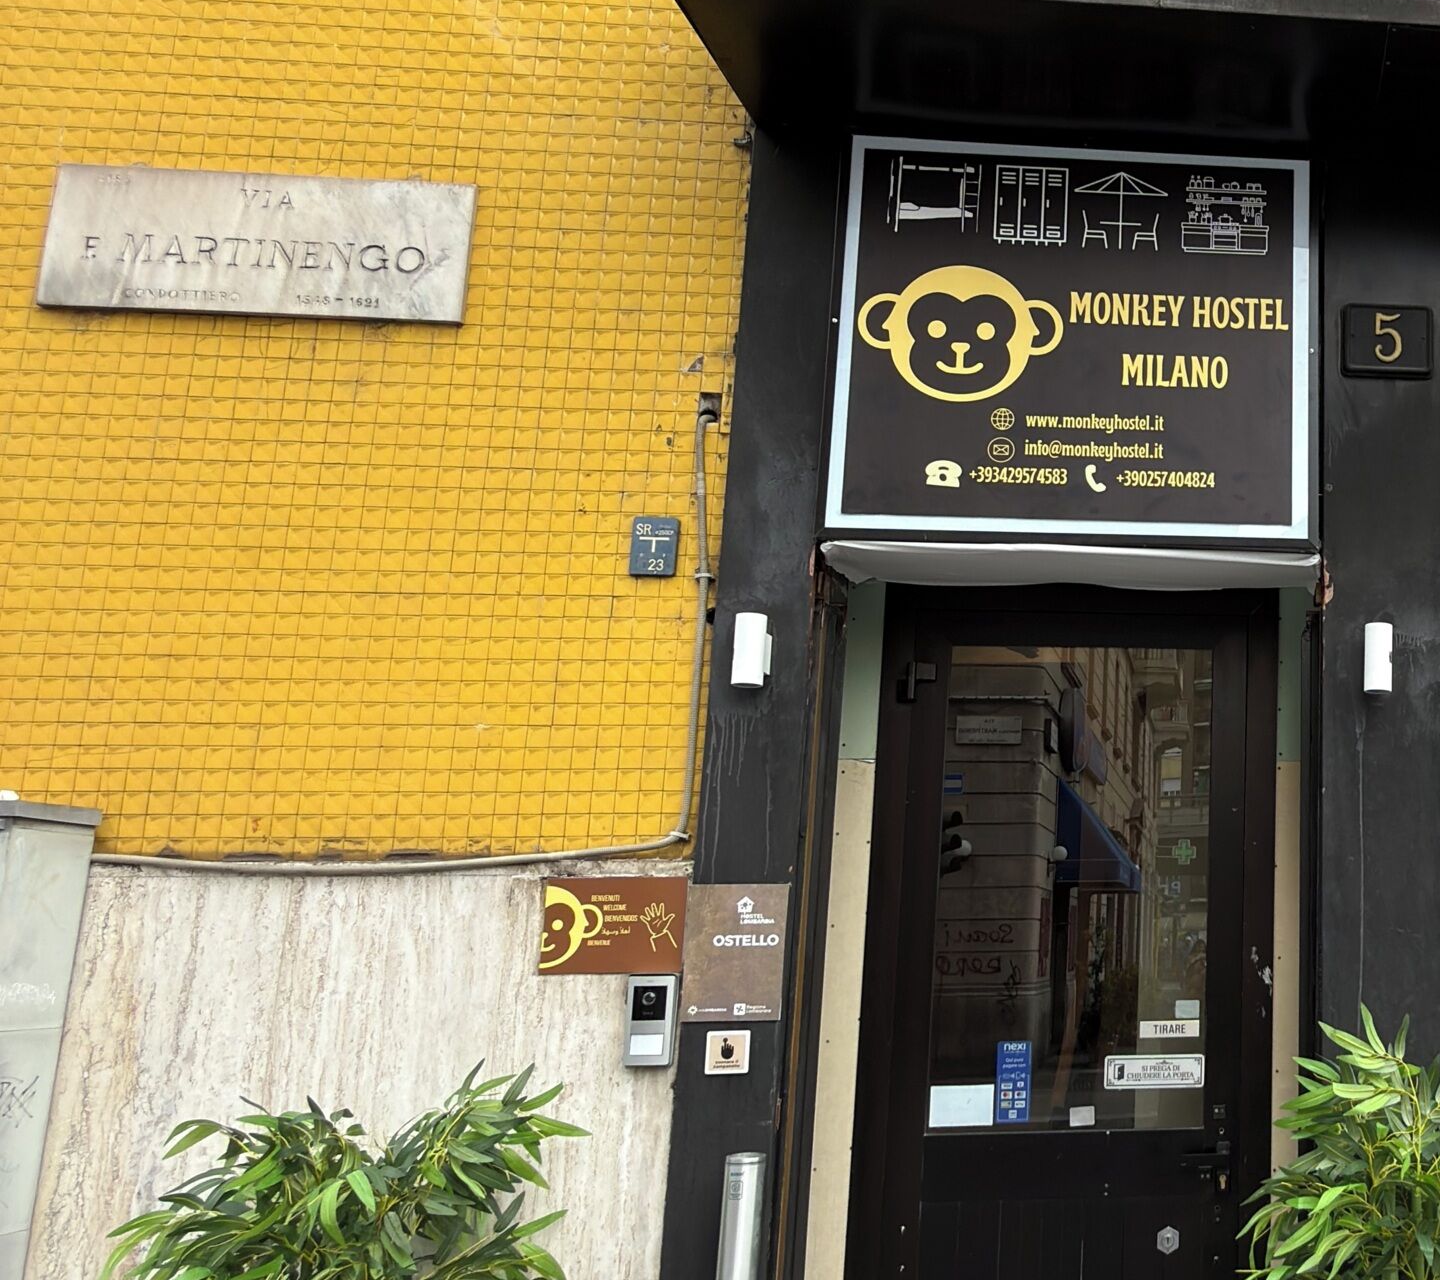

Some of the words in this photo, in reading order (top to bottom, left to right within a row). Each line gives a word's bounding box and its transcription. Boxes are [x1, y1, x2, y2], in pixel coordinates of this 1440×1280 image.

[240, 188, 295, 209] VIA
[116, 232, 426, 274] MARTINENGO
[124, 288, 240, 301] CONDOTTIERO
[1069, 291, 1185, 327] MONKEY
[1193, 295, 1289, 331] HOSTEL
[1375, 312, 1402, 362] 5
[1121, 353, 1228, 389] MILANO
[1025, 412, 1165, 434] www.monkeyhostel.it
[1024, 439, 1164, 462] info@monkeyhostel.it
[969, 466, 1068, 486] +393429574583
[1116, 470, 1216, 489] +390257404824
[636, 523, 652, 535] SR
[647, 559, 664, 571] 23
[591, 894, 620, 902] BENVENUTI
[713, 934, 779, 947] OSTELLO
[1153, 1024, 1186, 1035] TIRARE
[1004, 1042, 1026, 1051] nexi
